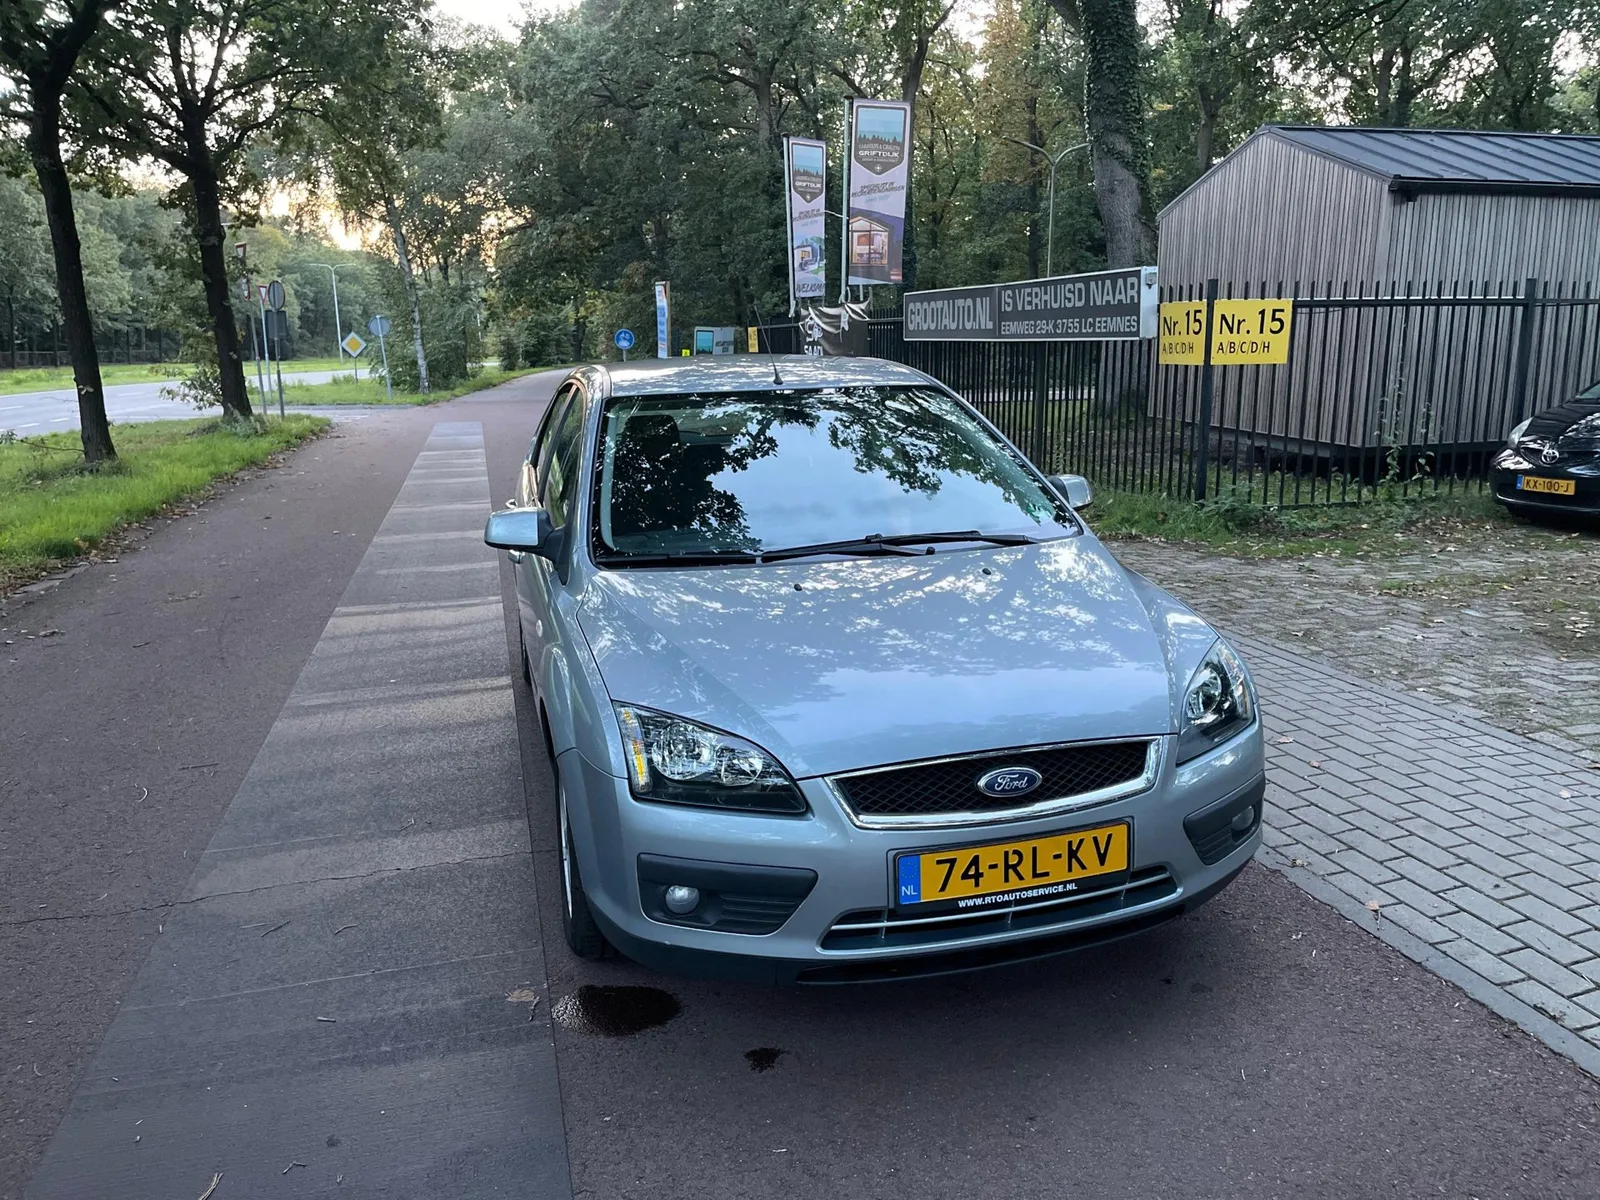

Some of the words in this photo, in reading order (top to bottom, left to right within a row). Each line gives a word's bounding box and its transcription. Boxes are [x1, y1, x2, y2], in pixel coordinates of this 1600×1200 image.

[858, 150, 900, 158] GRIFTDIJK
[1001, 288, 1013, 312] IS
[1016, 282, 1086, 312] VERHUISD
[1089, 276, 1138, 307] NAAR
[907, 296, 994, 332] GROOTAUTO.NL
[1001, 320, 1035, 335] EEMWEG
[1036, 319, 1055, 334] 29-K
[1056, 318, 1080, 334] 3755
[1081, 317, 1094, 333] LC
[1095, 315, 1138, 333] EEMNES
[1162, 316, 1182, 336] Nr.
[1186, 309, 1203, 336] 15
[1219, 313, 1251, 335] Nr.
[1258, 308, 1285, 335] 15
[1216, 341, 1271, 355] A/B/C/D/H
[1525, 479, 1570, 493] KX-100-J
[994, 773, 1028, 791] Ford
[935, 832, 1113, 893] 74-RL-KV
[901, 885, 918, 896] NL
[957, 882, 1078, 908] WWW.RTOAUTOSERVICE.NL
